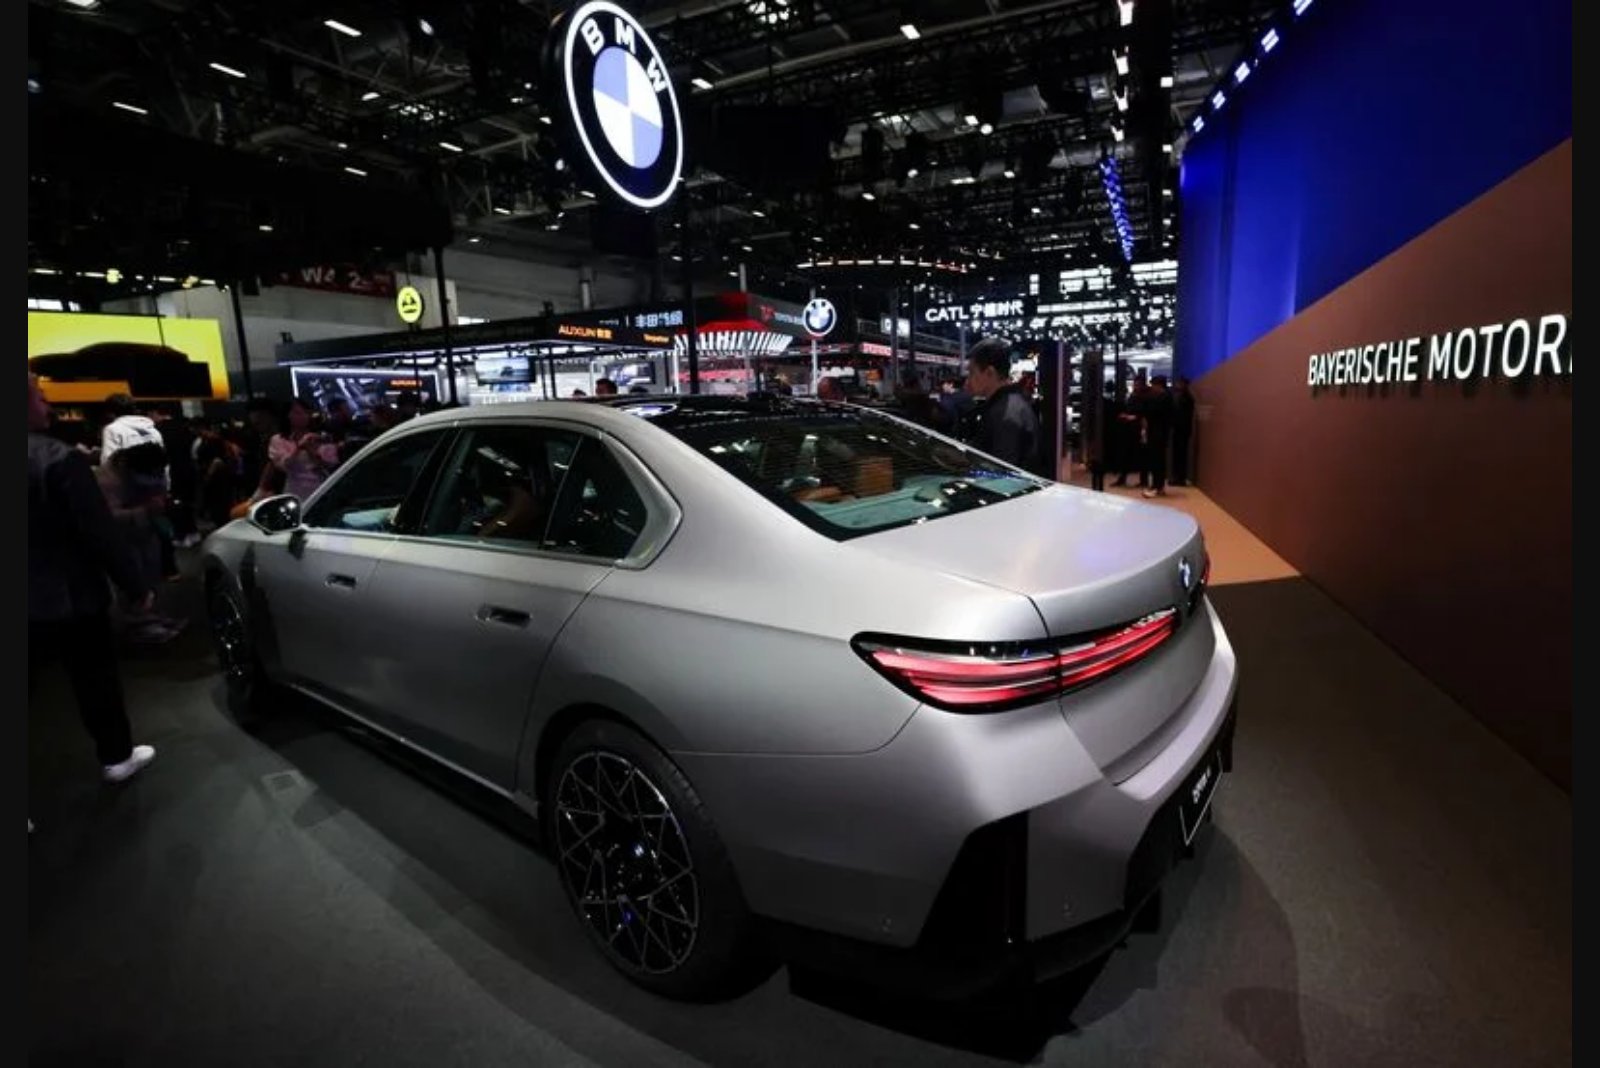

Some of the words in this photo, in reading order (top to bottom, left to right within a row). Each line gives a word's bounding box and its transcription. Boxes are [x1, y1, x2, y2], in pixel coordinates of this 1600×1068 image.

[580, 18, 668, 93] BMW
[925, 305, 969, 322] CATL
[1308, 337, 1420, 386] BAYERISCHE
[1427, 313, 1572, 381] MOTOR
